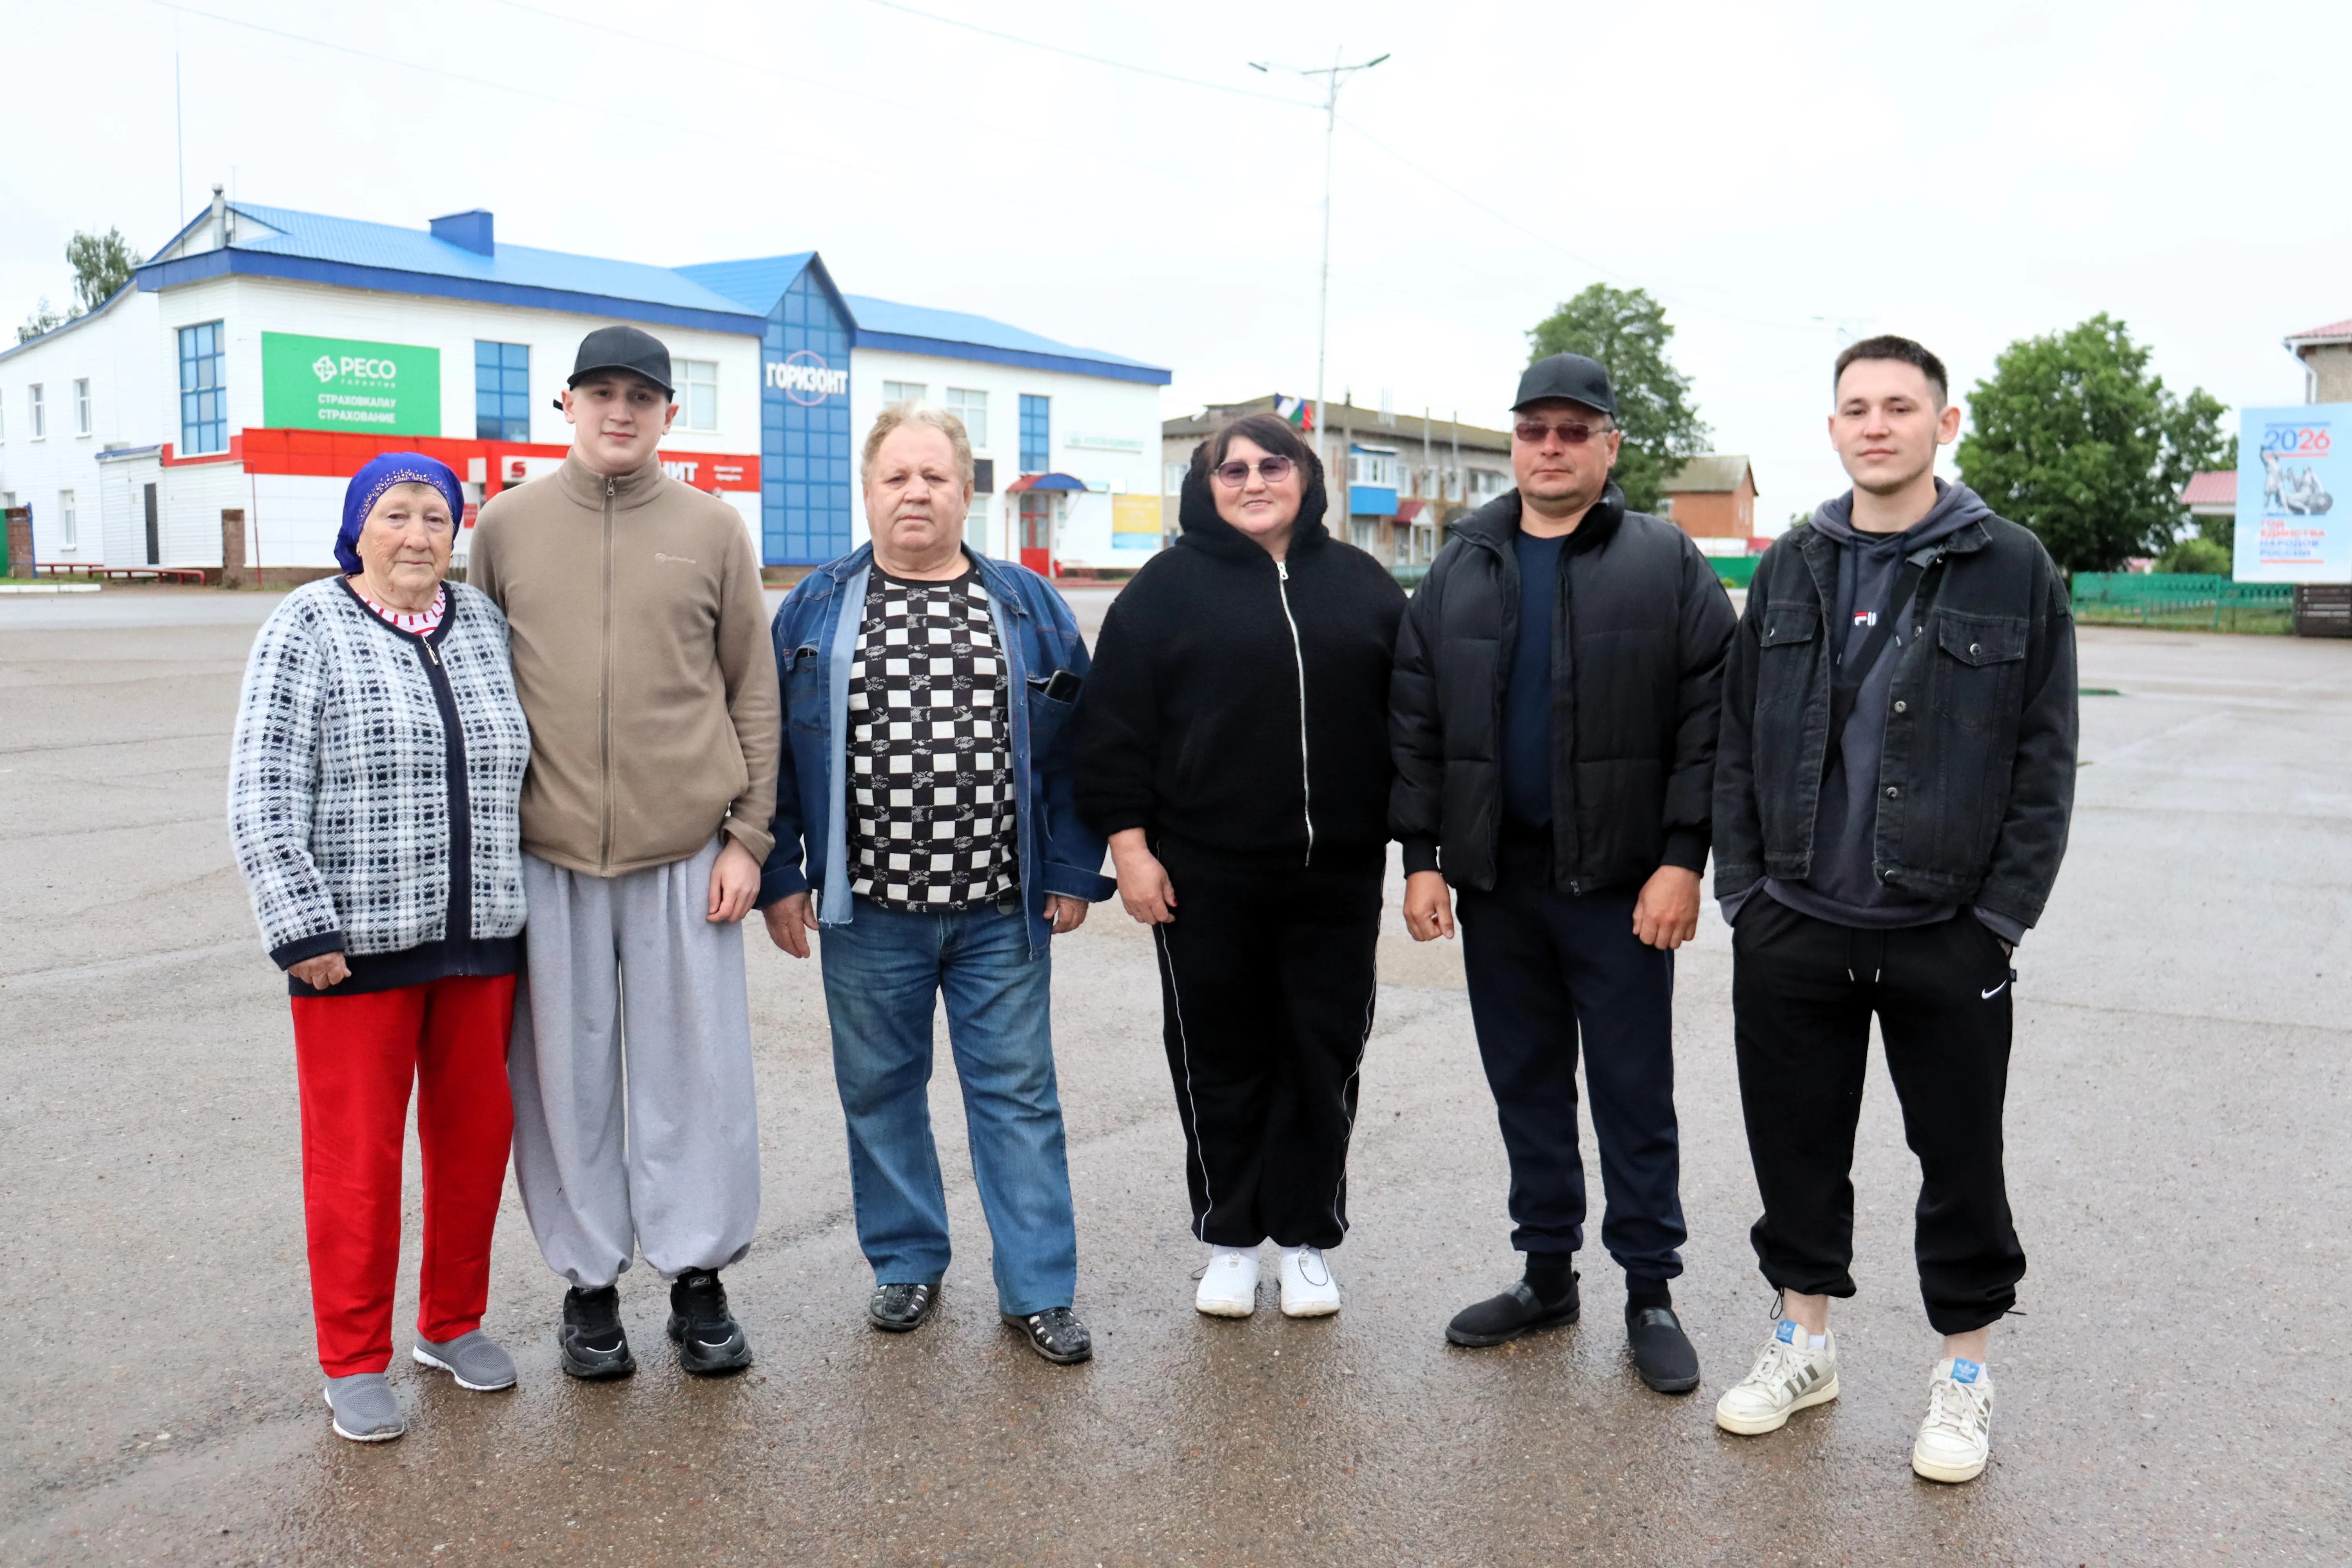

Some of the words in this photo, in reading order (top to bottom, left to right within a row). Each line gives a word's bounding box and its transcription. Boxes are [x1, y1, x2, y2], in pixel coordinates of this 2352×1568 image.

[340, 356, 396, 379] РЕСО
[766, 363, 848, 394] ГОРИЗОНТ
[318, 409, 396, 423] СТРАХОВАНИЕ
[2265, 427, 2331, 450] 2026
